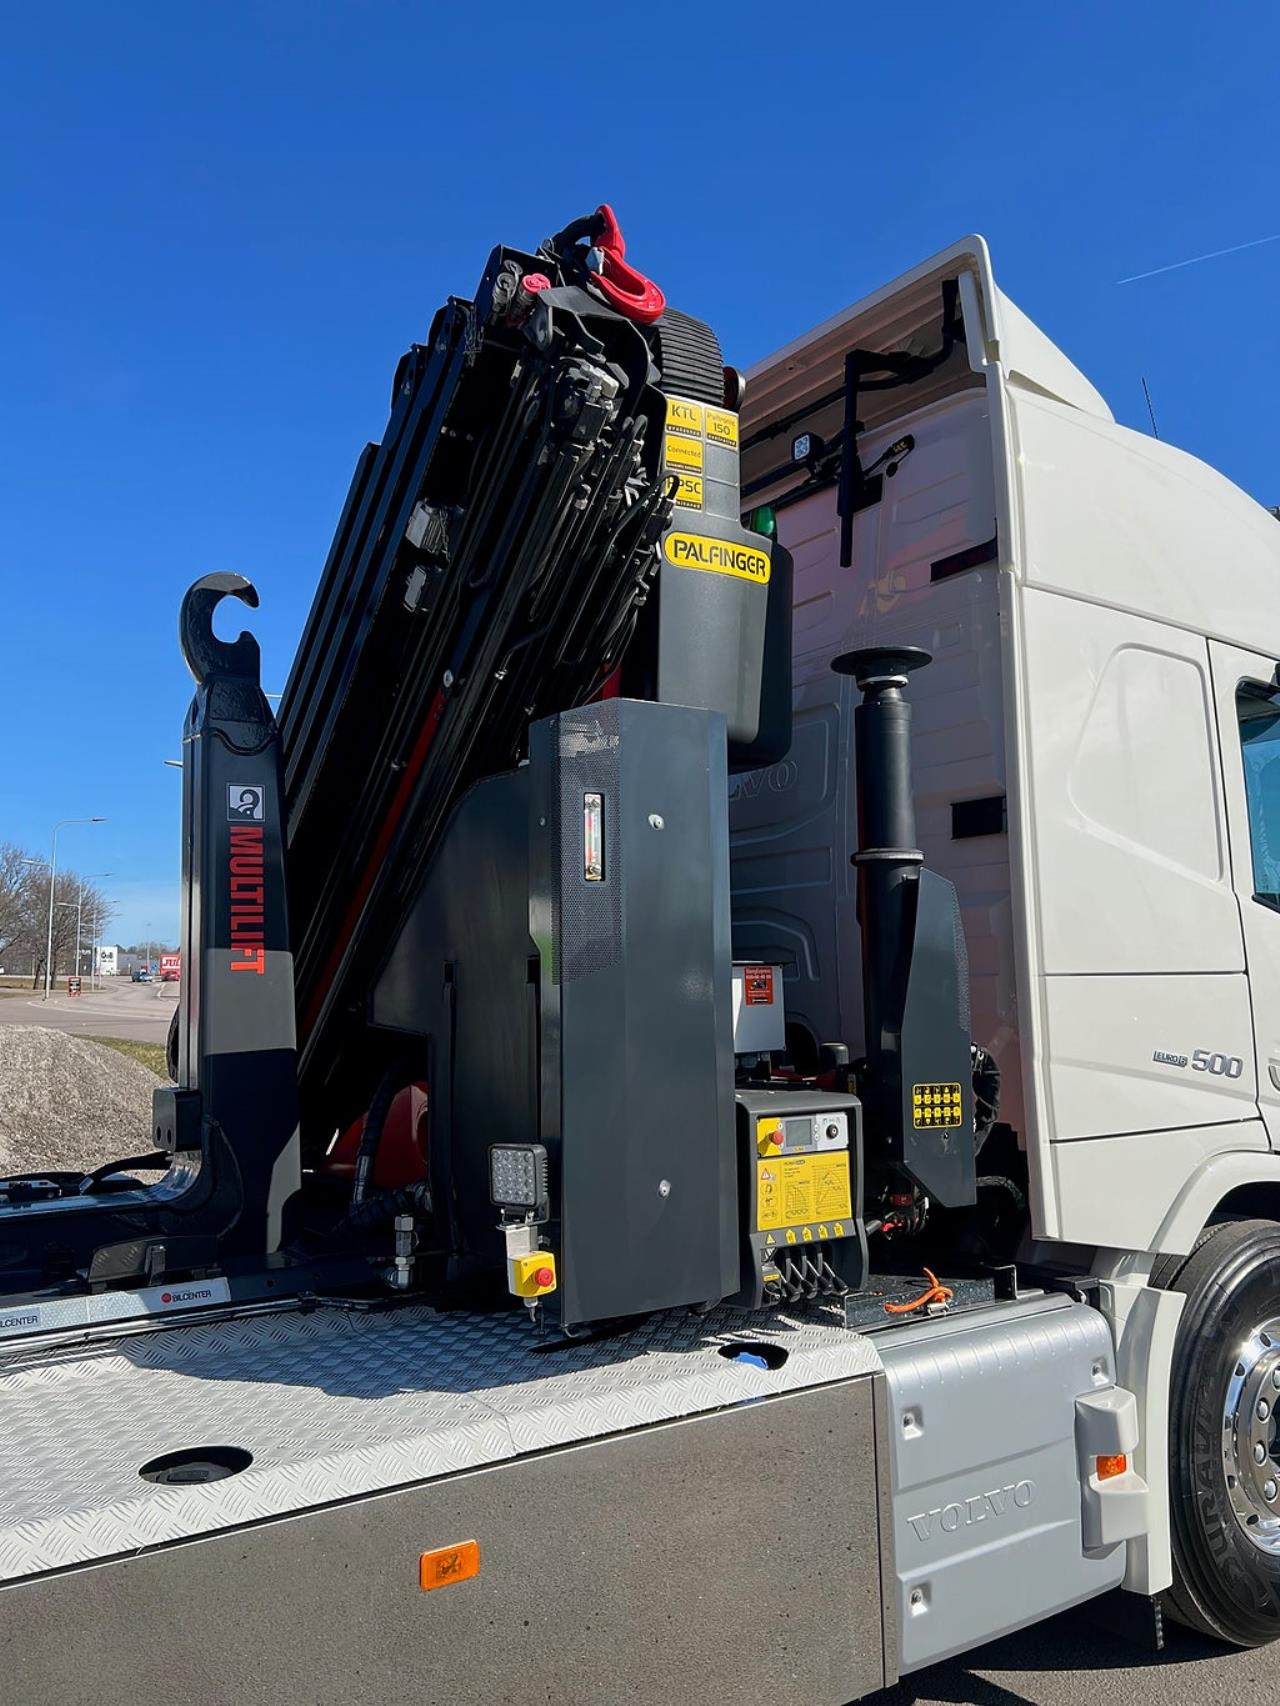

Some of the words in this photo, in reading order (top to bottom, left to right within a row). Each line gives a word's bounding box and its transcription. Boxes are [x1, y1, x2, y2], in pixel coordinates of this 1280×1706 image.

[671, 403, 697, 421] KTL
[713, 421, 731, 436] 150
[667, 445, 701, 458] Connected
[673, 538, 767, 578] PALFINGER
[229, 825, 265, 975] MULTILIFT
[1191, 1048, 1244, 1079] 500
[172, 1289, 212, 1303] BILCENTER
[906, 1479, 1036, 1542] VOLVO
